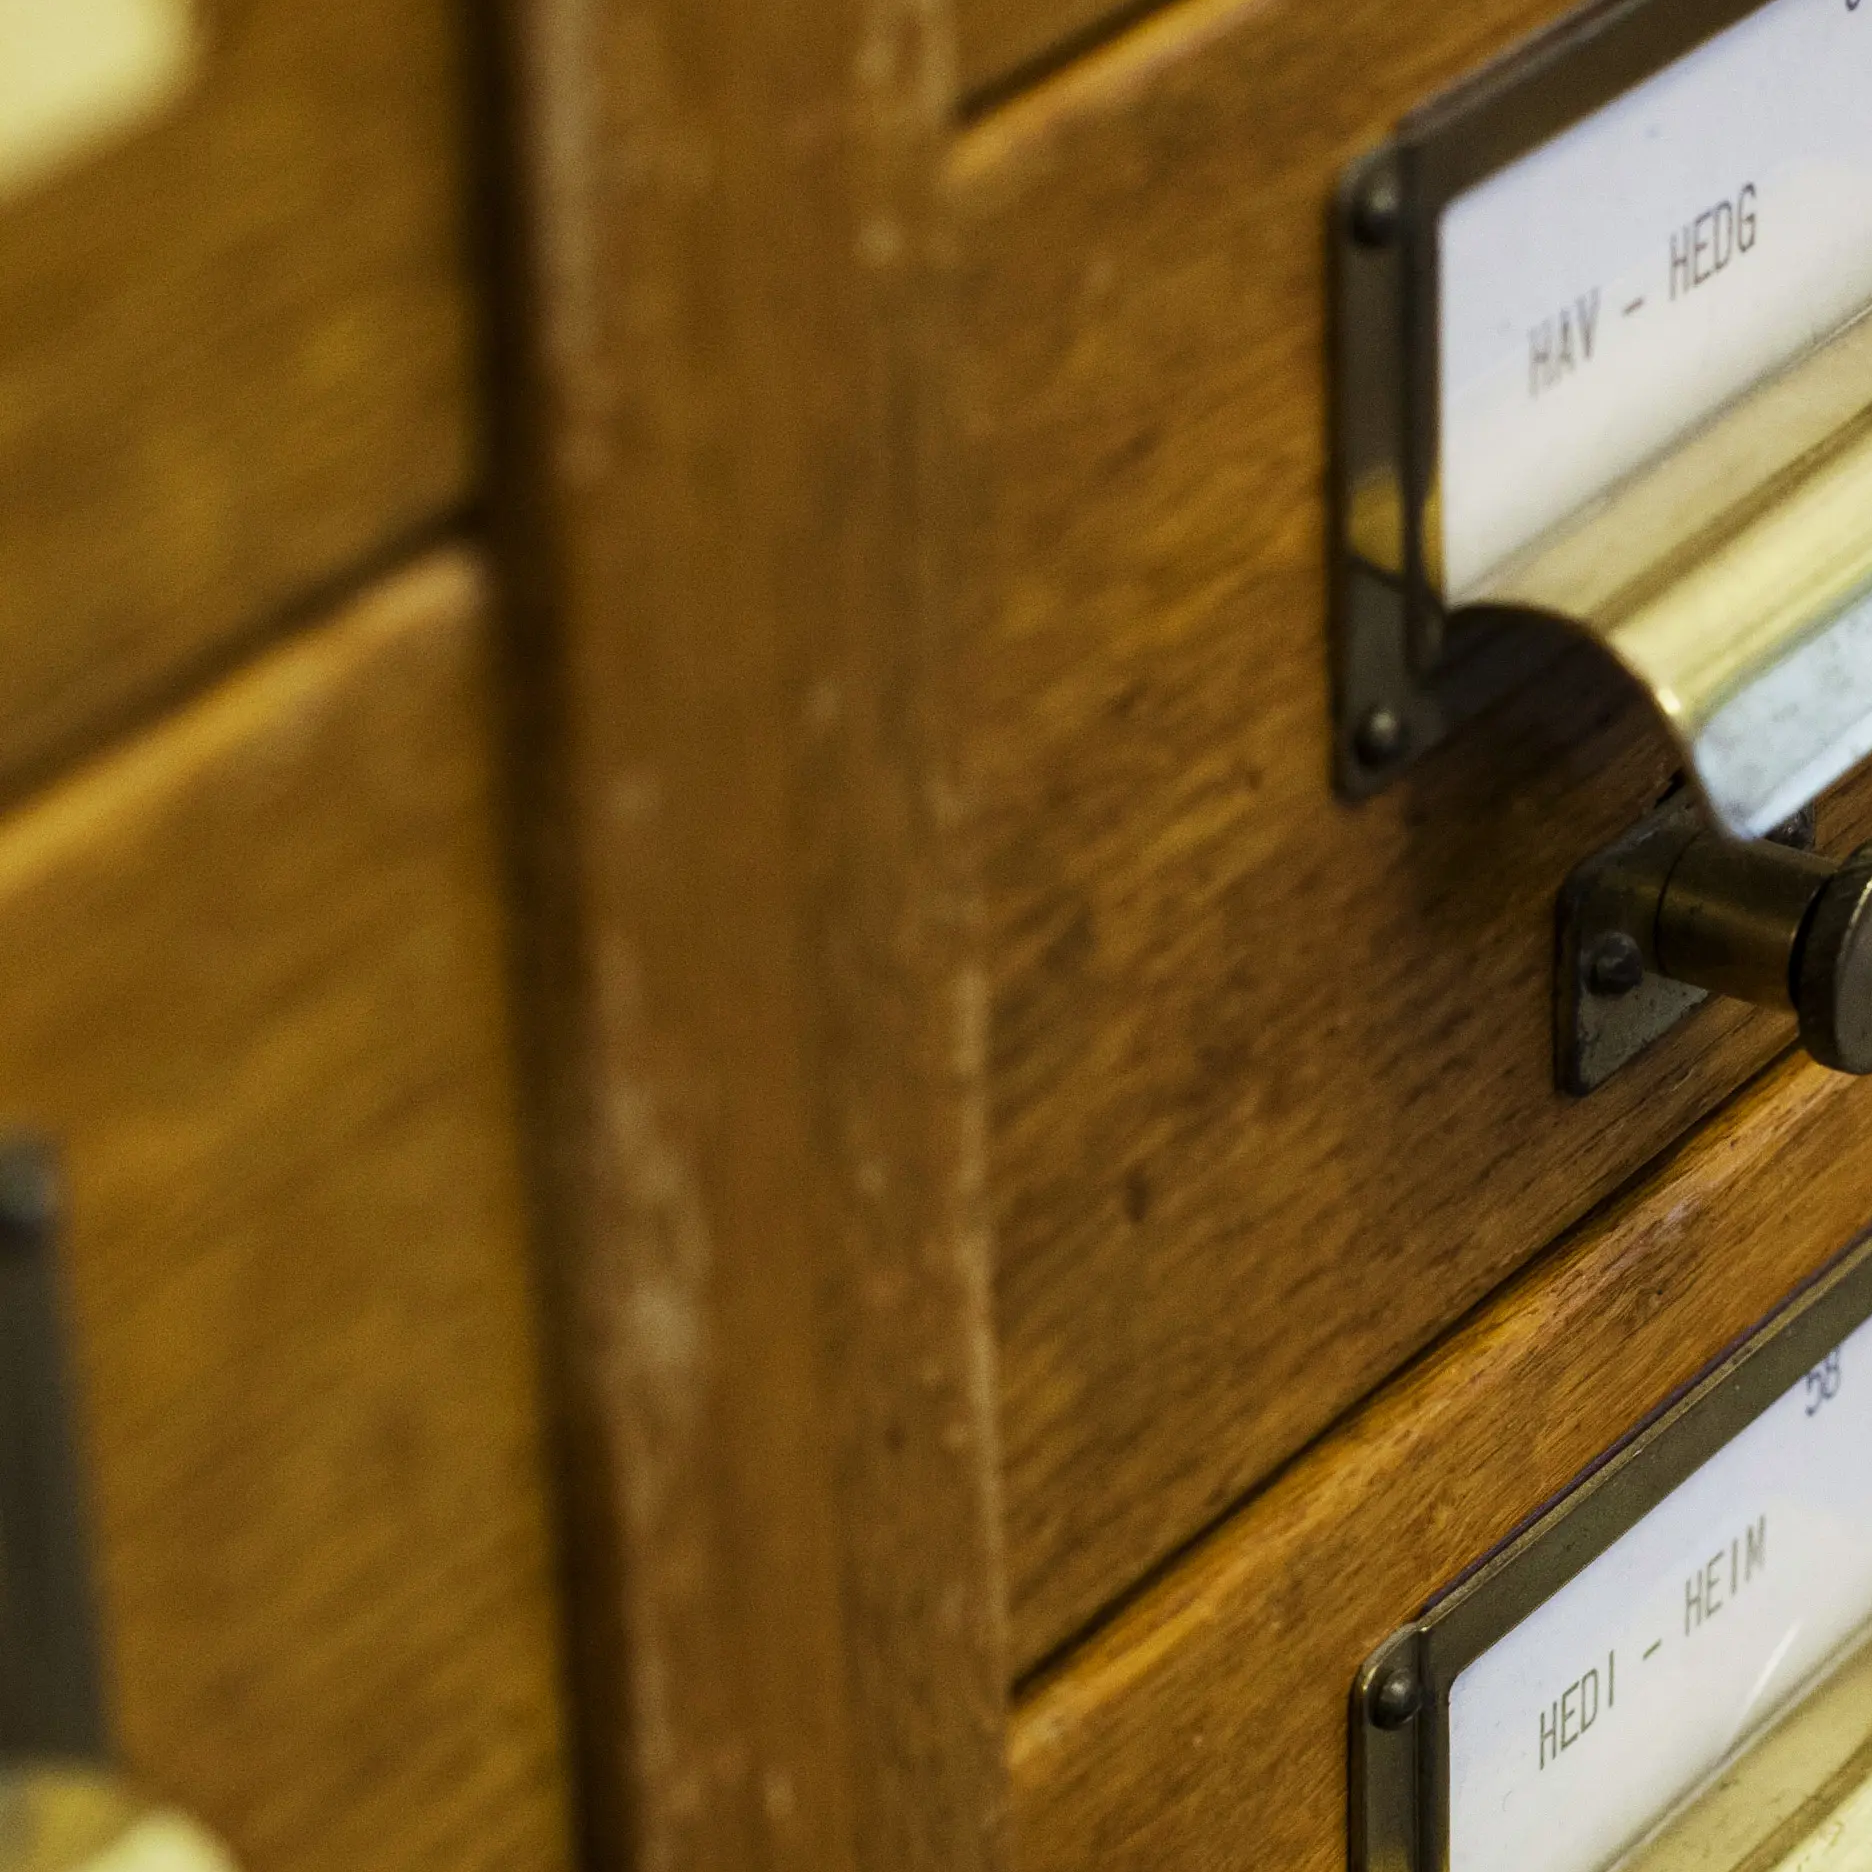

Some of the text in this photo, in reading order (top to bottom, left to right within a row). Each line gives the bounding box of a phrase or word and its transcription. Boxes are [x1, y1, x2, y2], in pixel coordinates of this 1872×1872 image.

[1528, 286, 1601, 398] HAV
[1669, 183, 1758, 302] HEDG
[1538, 1650, 1616, 1771] HEDI
